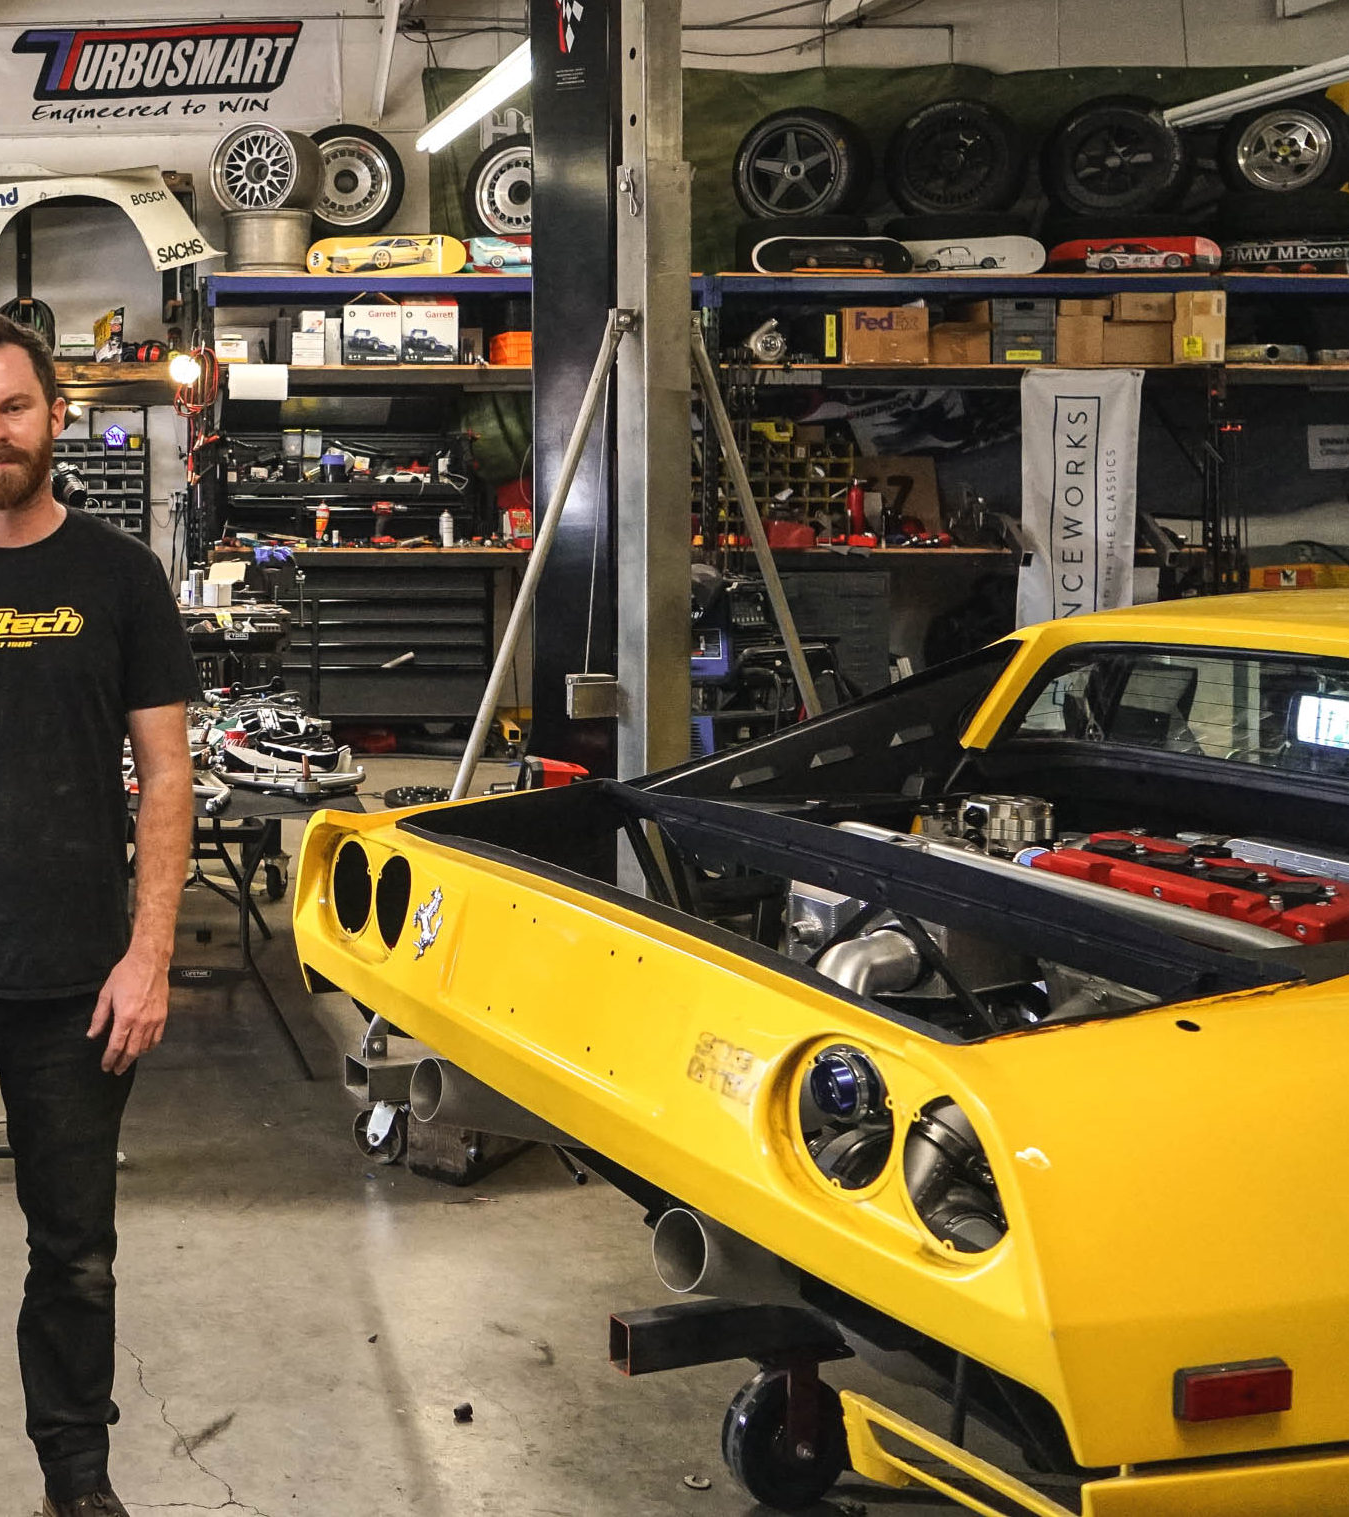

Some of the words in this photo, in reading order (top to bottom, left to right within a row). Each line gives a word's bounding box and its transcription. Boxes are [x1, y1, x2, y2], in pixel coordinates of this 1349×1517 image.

[24, 23, 300, 91] TURBOSMART
[32, 101, 171, 123] Engineered
[181, 101, 206, 115] to
[219, 97, 270, 114] WIN
[130, 189, 167, 206] BOSCH
[156, 239, 203, 265] SACHS
[1277, 246, 1296, 260] M
[368, 310, 397, 318] Garrett
[425, 310, 454, 318] Garrett
[854, 310, 919, 331] FedEx
[1106, 449, 1116, 523] CLASSICS
[1106, 531, 1116, 559] THE
